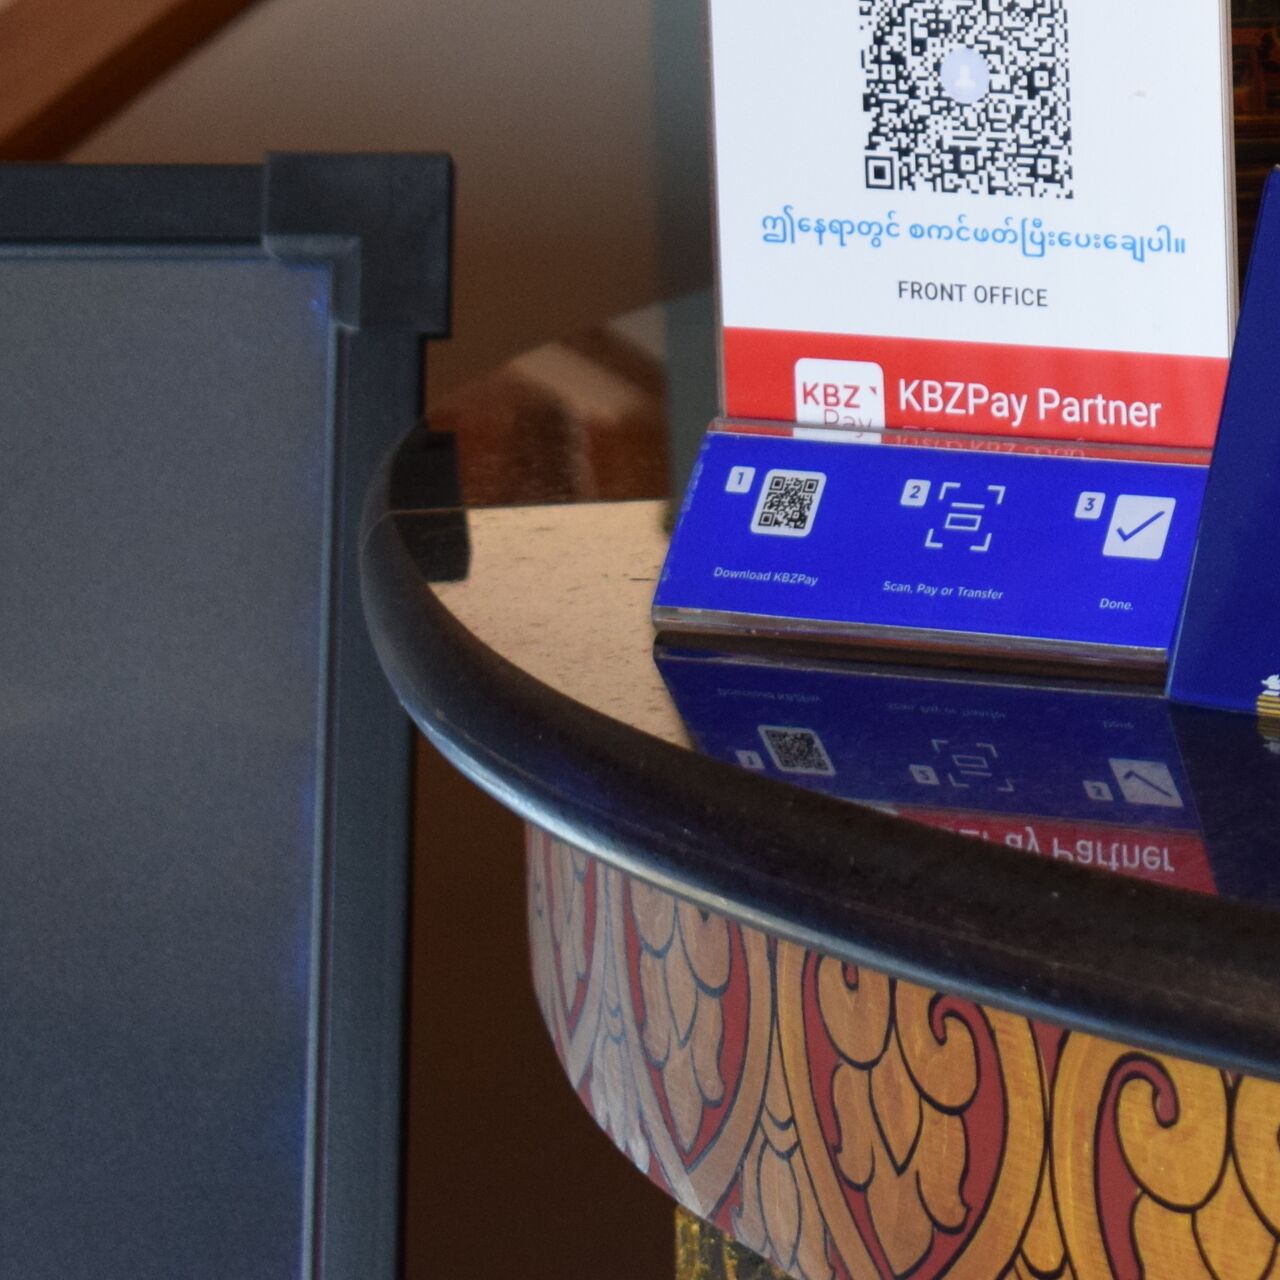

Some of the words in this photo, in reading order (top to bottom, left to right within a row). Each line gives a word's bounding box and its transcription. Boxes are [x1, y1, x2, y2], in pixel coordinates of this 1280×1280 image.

[898, 281, 967, 302] FRONT
[974, 285, 1048, 307] OFFICE
[802, 382, 861, 409] KBZ
[899, 378, 1028, 427] KBZPay
[1038, 386, 1162, 428] Partner
[713, 567, 771, 582] Download
[773, 572, 818, 587] KBZPay
[916, 582, 938, 596] Pay
[941, 588, 954, 596] or
[957, 586, 1004, 601] Transfer
[1099, 597, 1134, 611] Done.
